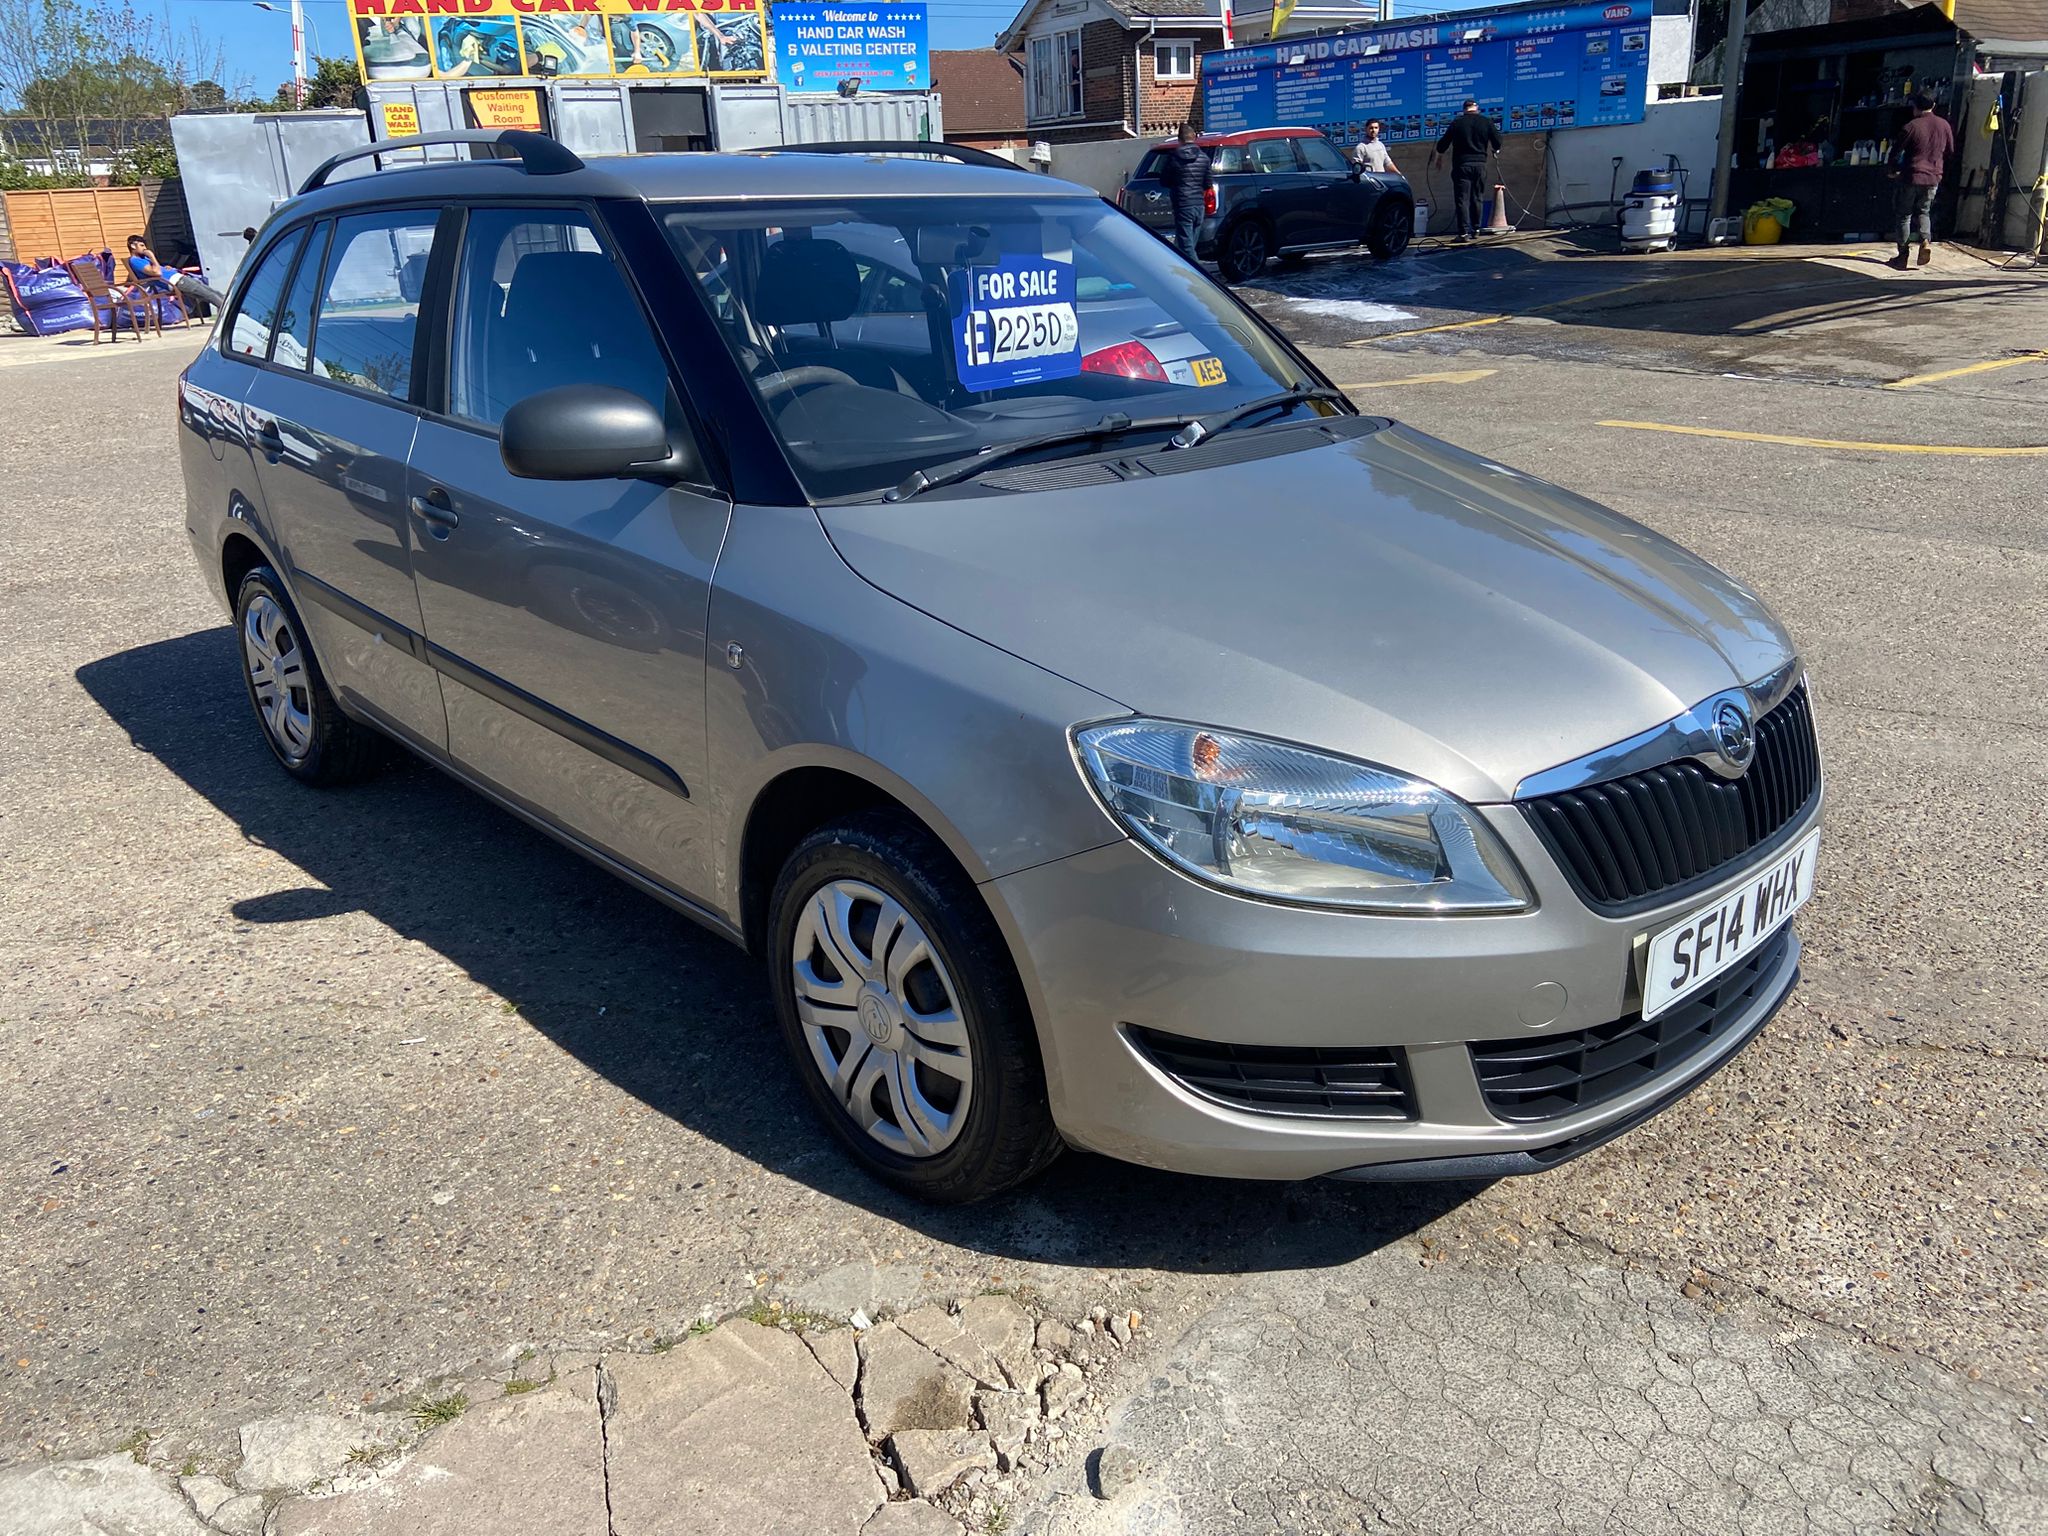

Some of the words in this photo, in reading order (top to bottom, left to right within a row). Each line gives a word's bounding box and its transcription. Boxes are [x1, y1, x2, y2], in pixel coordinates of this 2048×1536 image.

[354, 0, 493, 14] HAND
[512, 0, 600, 13] CAR
[628, 0, 757, 11] WASH
[1604, 8, 1630, 18] VANS
[822, 10, 868, 22] Welcome
[868, 11, 878, 21] to
[797, 27, 834, 39] HAND
[837, 26, 864, 39] CAR
[867, 26, 906, 38] WASH
[788, 43, 798, 56] &
[801, 43, 862, 56] VALETING
[865, 42, 917, 55] CENTER
[1276, 43, 1330, 64] HAND
[1333, 34, 1373, 56] CAR
[1376, 28, 1438, 50] WASH
[475, 91, 530, 101] Customers
[385, 106, 414, 114] HAND
[487, 103, 525, 113] Waiting
[388, 121, 416, 129] WASH
[493, 114, 523, 124] Room
[31, 276, 72, 295] JEWSON
[977, 271, 1016, 301] FOR
[1018, 269, 1058, 298] SALE
[1198, 358, 1223, 383] AE5
[1670, 894, 1746, 991] SF14
[1752, 848, 1806, 938] WHX
